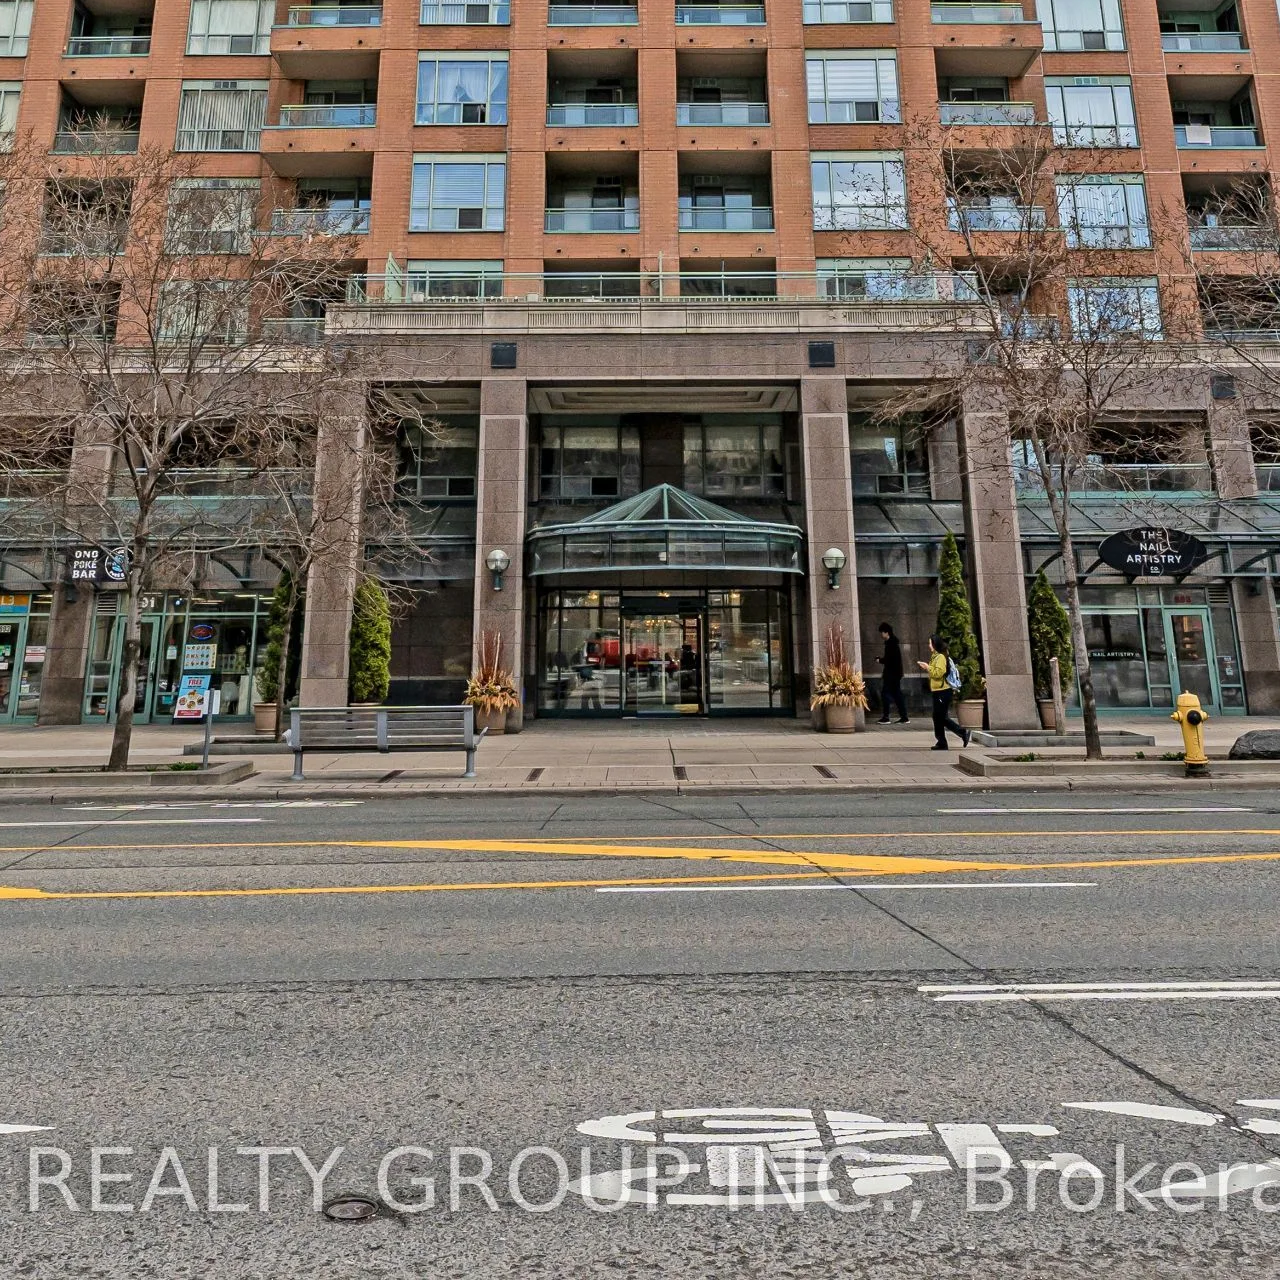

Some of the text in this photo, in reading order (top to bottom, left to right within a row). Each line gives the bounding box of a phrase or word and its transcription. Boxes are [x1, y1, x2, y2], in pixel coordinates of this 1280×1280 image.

[1141, 530, 1163, 540] THE
[1140, 542, 1165, 552] NAIL
[74, 550, 99, 559] ONO
[1126, 554, 1182, 564] ARTISTRY
[73, 559, 98, 569] POKÉ
[72, 570, 97, 579] BAR
